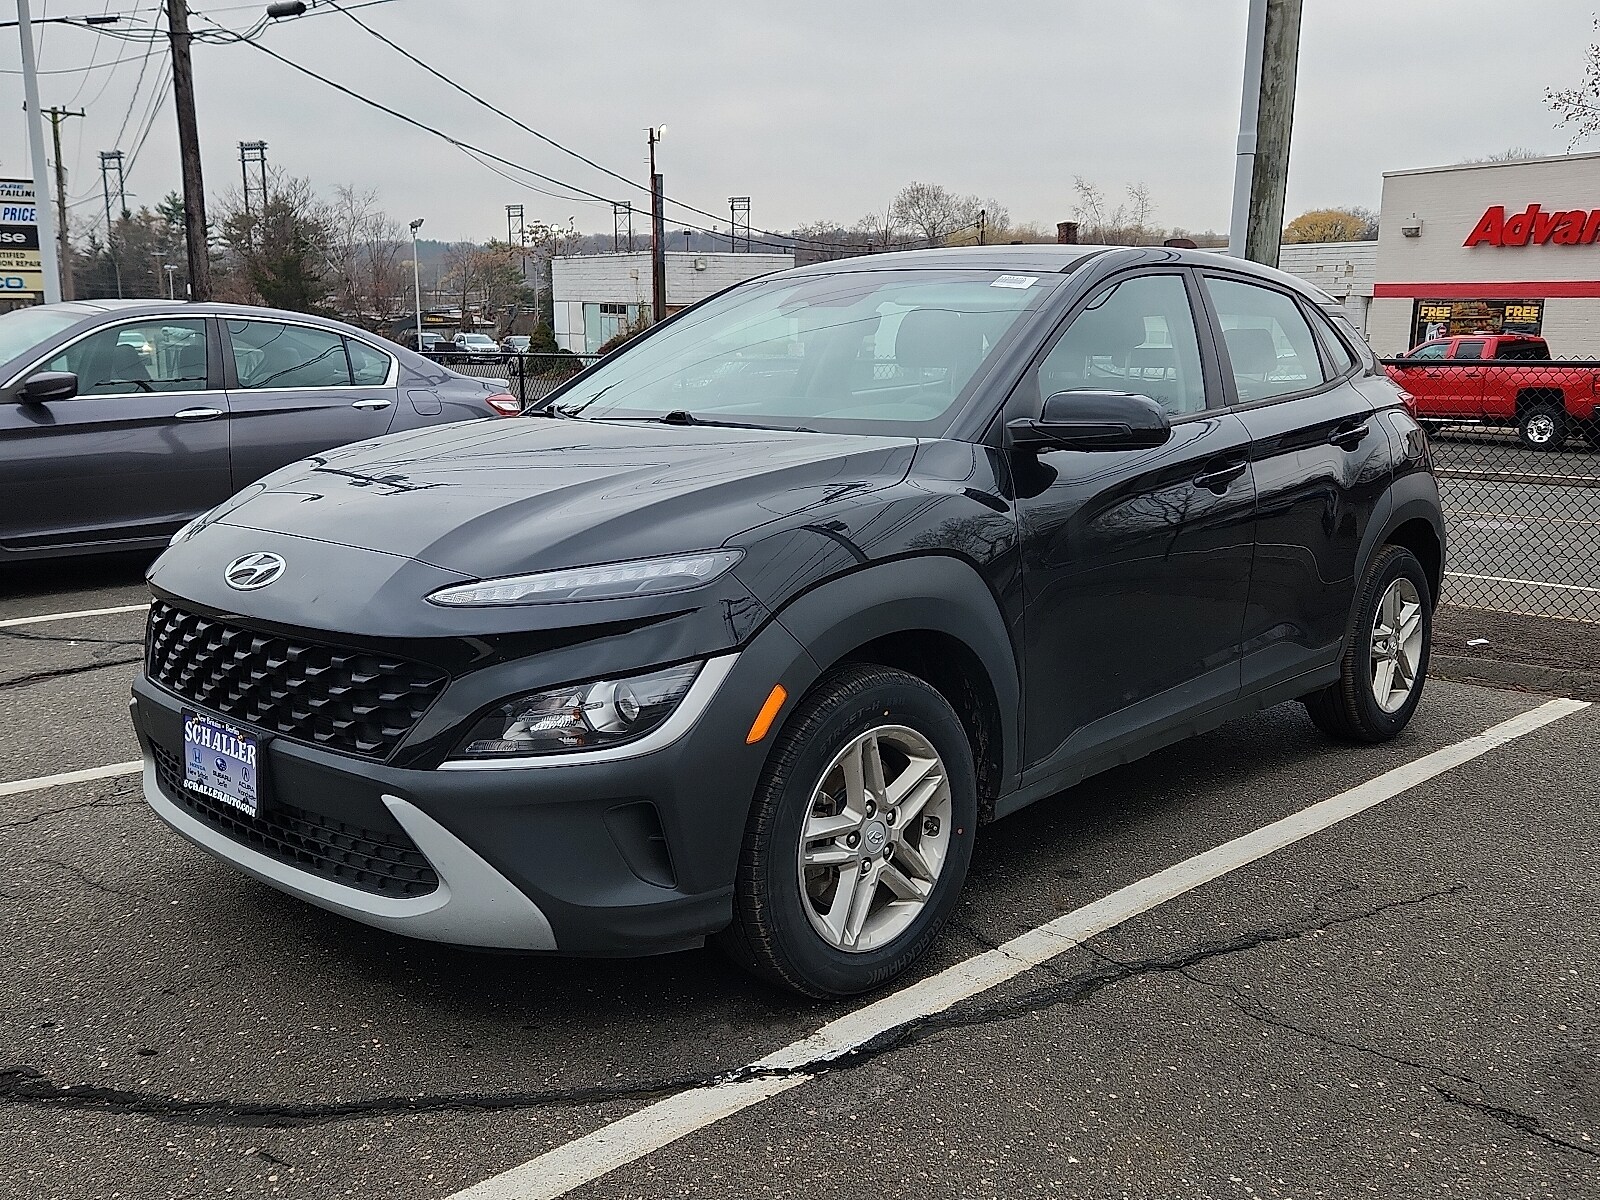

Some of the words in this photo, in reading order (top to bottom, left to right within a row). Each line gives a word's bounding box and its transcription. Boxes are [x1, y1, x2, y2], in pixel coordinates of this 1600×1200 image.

[3, 207, 38, 221] PRICE
[1420, 306, 1452, 317] FREE
[1505, 305, 1540, 317] FREE
[184, 720, 257, 770] SCHALLER
